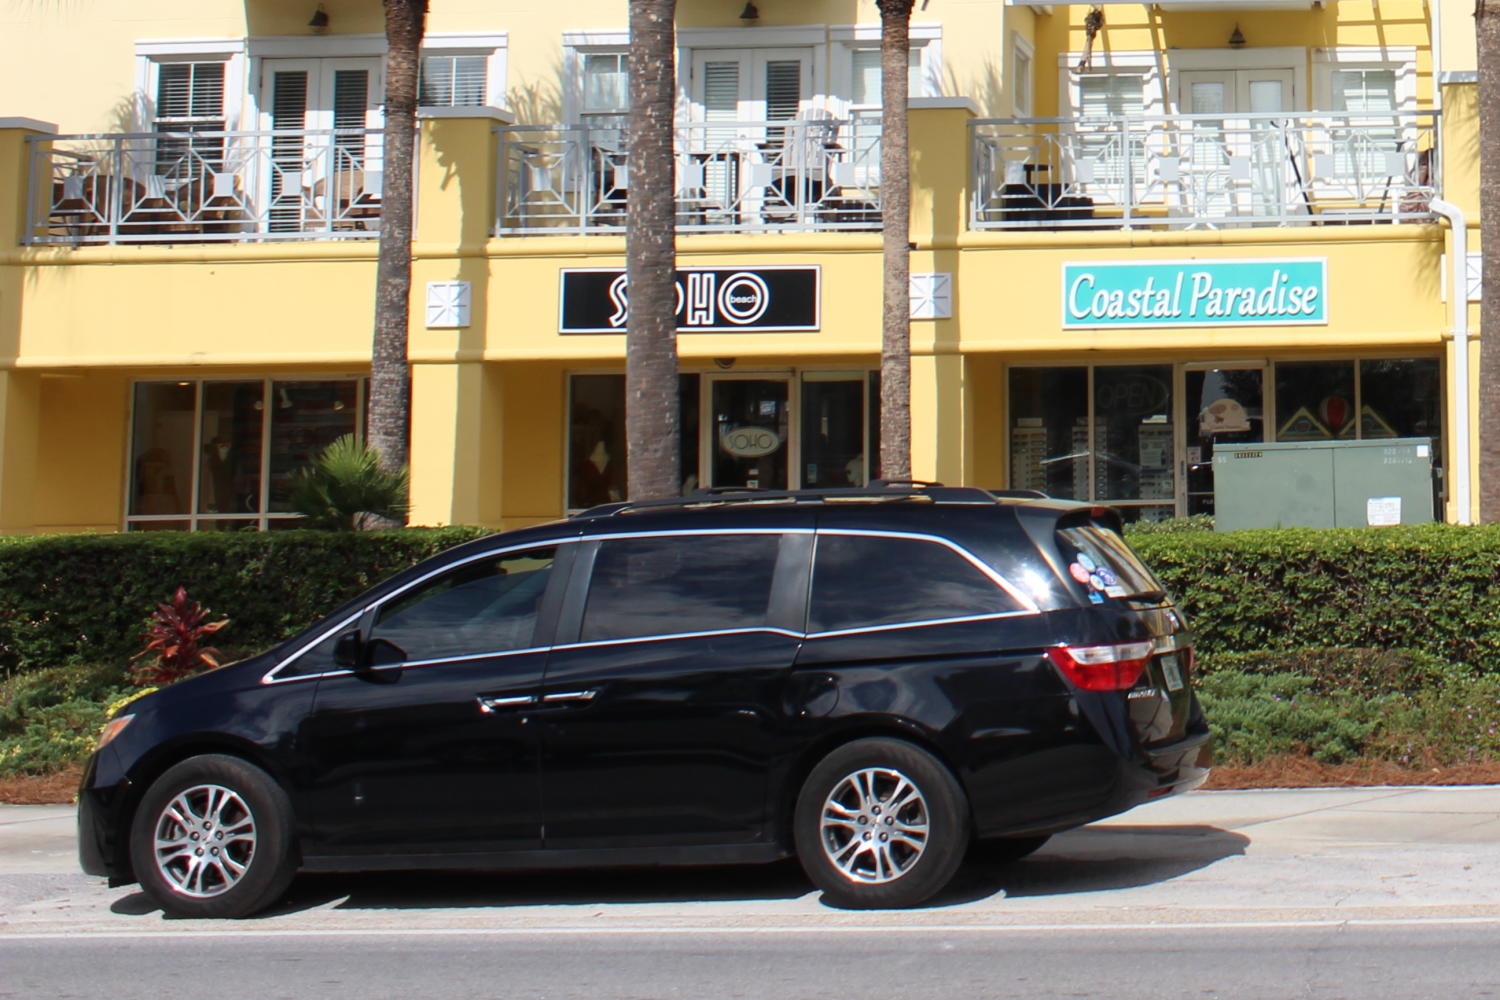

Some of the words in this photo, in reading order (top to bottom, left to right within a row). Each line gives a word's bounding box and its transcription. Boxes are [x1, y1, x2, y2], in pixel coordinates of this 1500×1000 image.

[608, 271, 770, 328] SHO
[729, 294, 757, 305] beach
[1068, 271, 1184, 319] Coastal
[1188, 269, 1318, 317] Paradise
